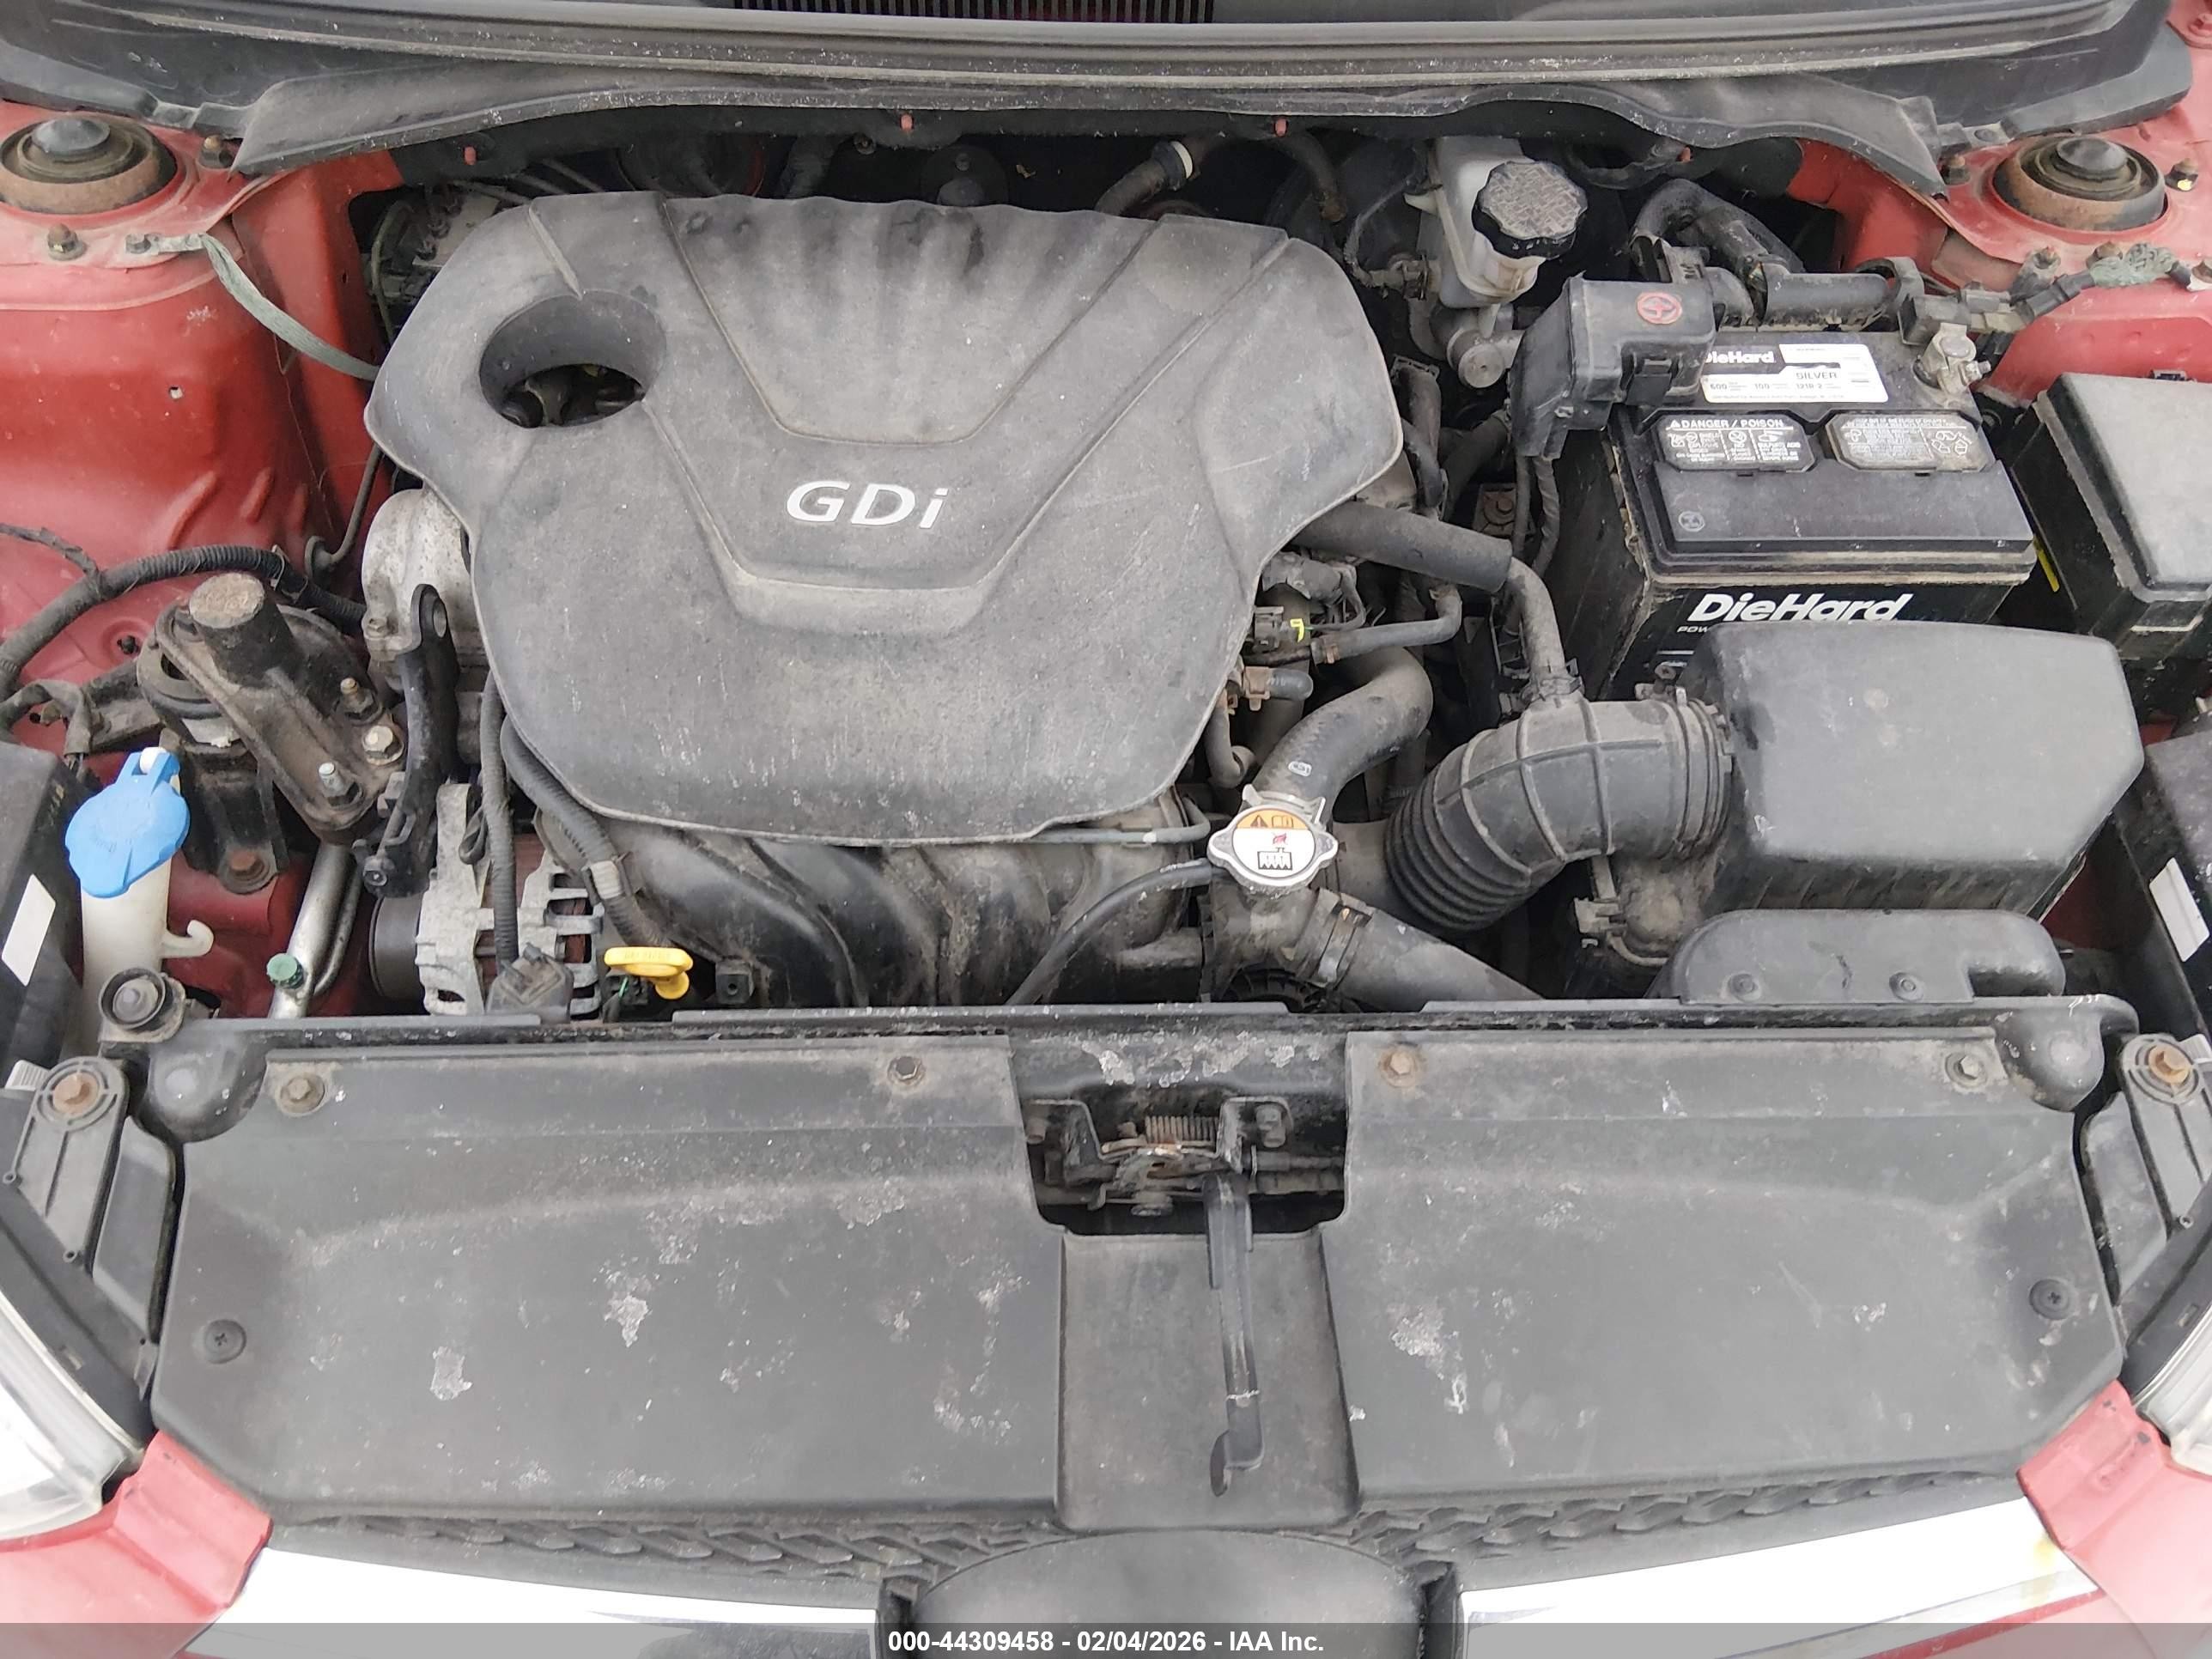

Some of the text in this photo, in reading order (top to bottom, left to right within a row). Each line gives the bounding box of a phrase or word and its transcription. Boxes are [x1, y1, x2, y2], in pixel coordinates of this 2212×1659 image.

[1681, 418, 1784, 428] DANGER / POISON
[787, 480, 949, 529] GDi
[1686, 592, 1914, 622] DieHard
